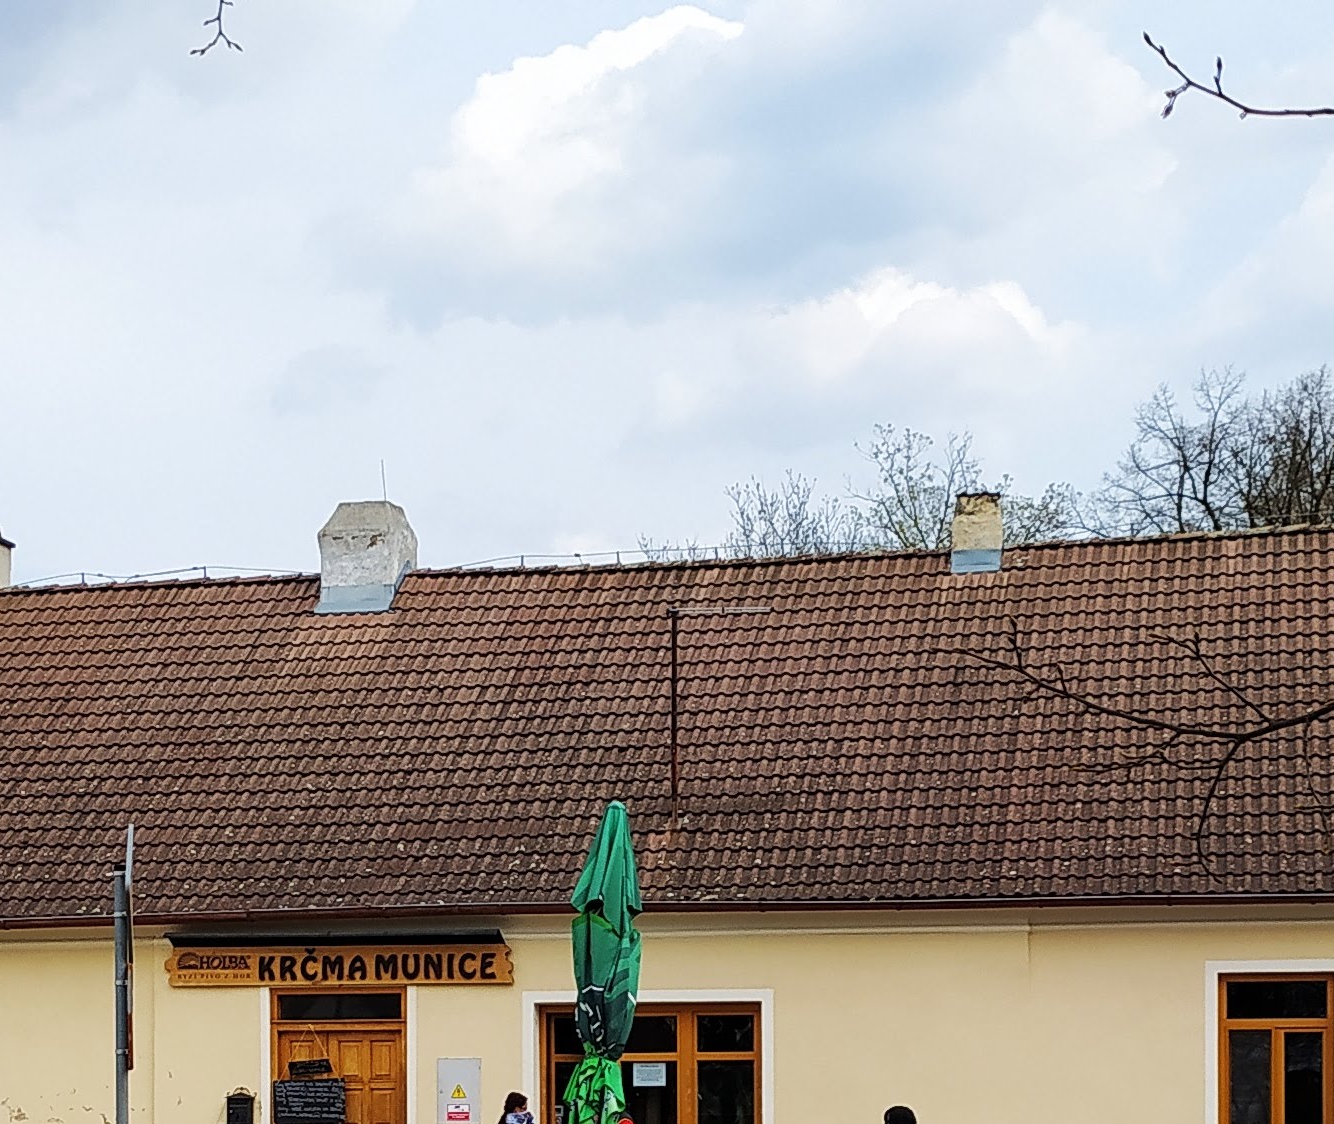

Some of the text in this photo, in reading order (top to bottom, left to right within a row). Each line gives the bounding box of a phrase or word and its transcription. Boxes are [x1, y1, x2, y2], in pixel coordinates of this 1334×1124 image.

[199, 955, 252, 971] HOLBA
[257, 947, 497, 982] KRČMA MUNICE
